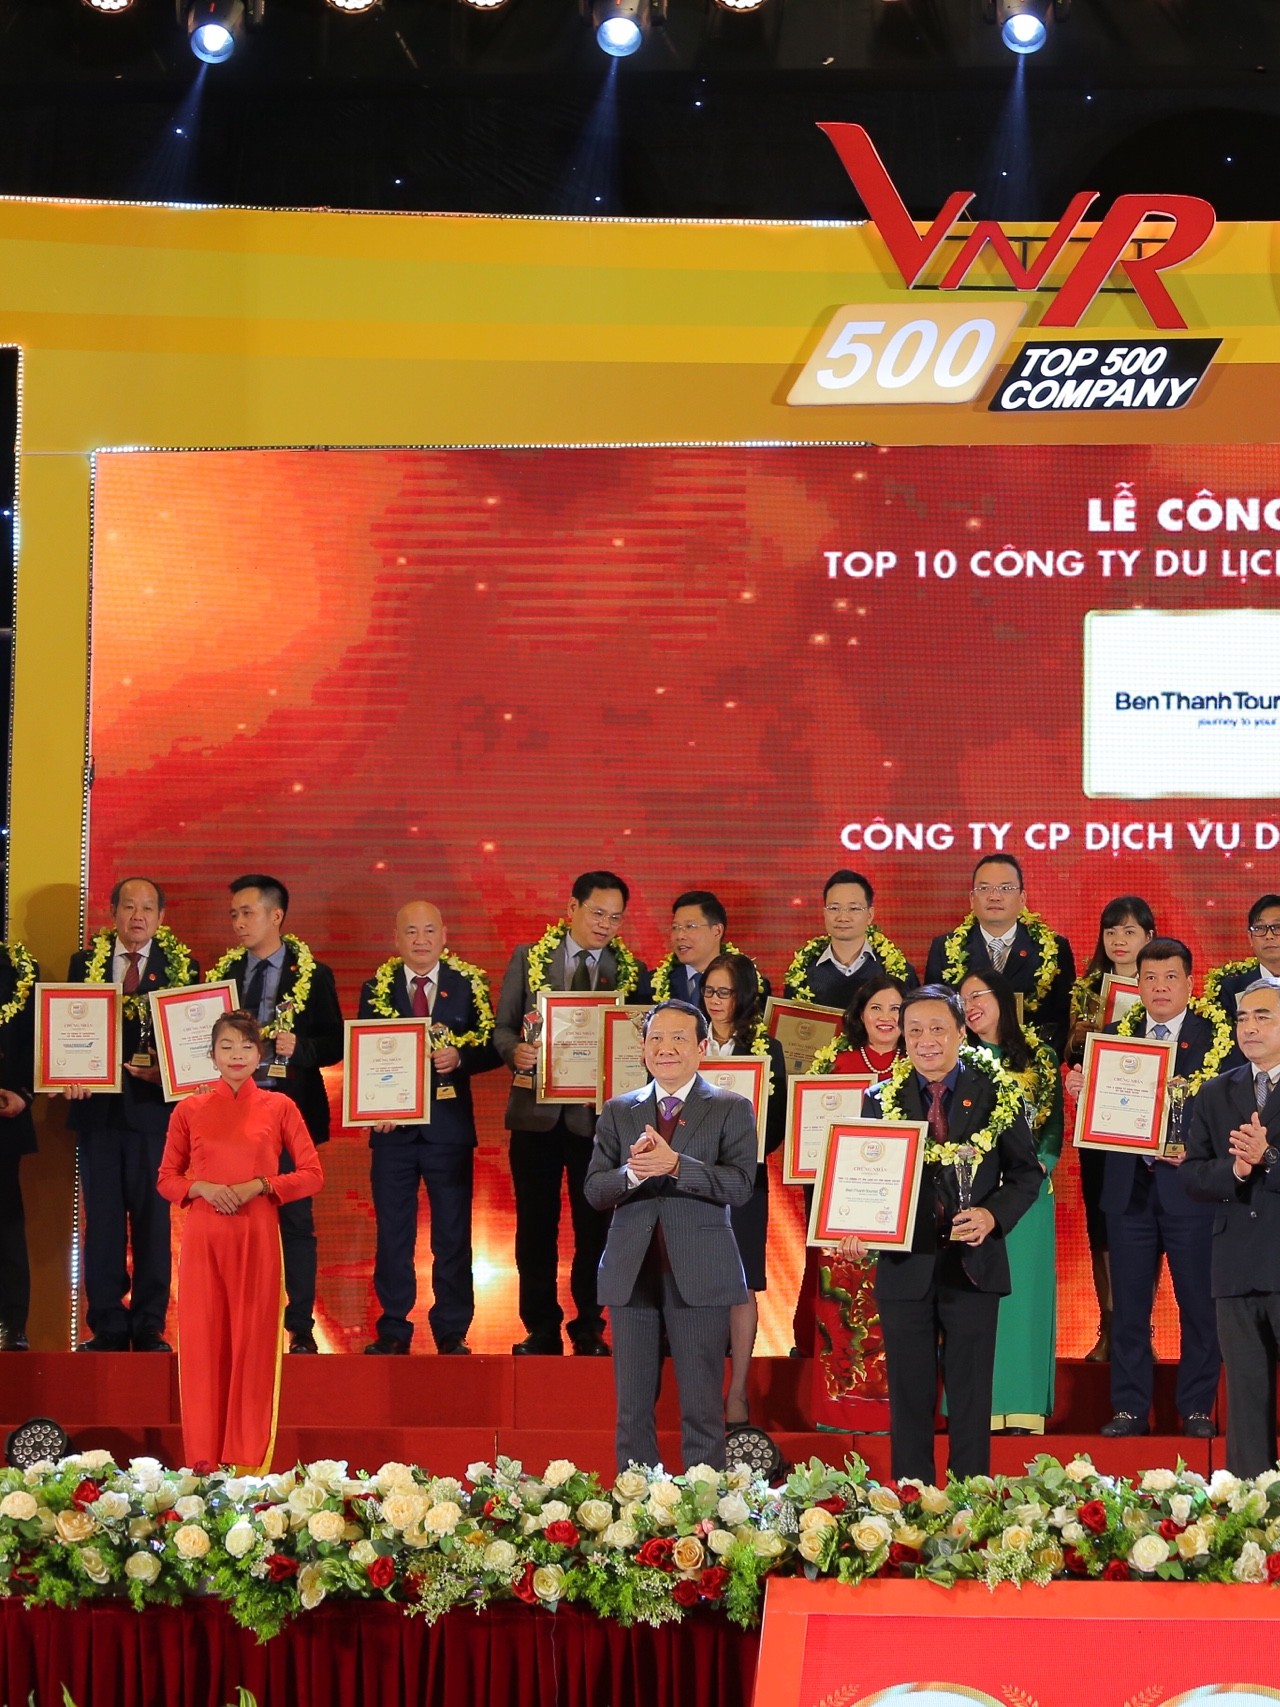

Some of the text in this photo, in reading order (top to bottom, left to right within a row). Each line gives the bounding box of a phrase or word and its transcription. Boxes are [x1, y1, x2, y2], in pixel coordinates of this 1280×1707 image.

[815, 318, 997, 390] 500
[1019, 346, 1168, 378] TOP 500
[1000, 376, 1198, 410] COMPANY
[1087, 482, 1137, 533] LỄ
[824, 551, 897, 579] TOP
[915, 550, 957, 579] 10
[970, 544, 1085, 578] CÔNG
[1098, 549, 1141, 578] TY
[1155, 550, 1209, 577] DU
[840, 816, 954, 851] CÔNG
[968, 822, 1012, 850] TY
[1024, 822, 1071, 850] CP
[1085, 822, 1173, 857] DỊCH
[1186, 821, 1240, 858] VỤ
